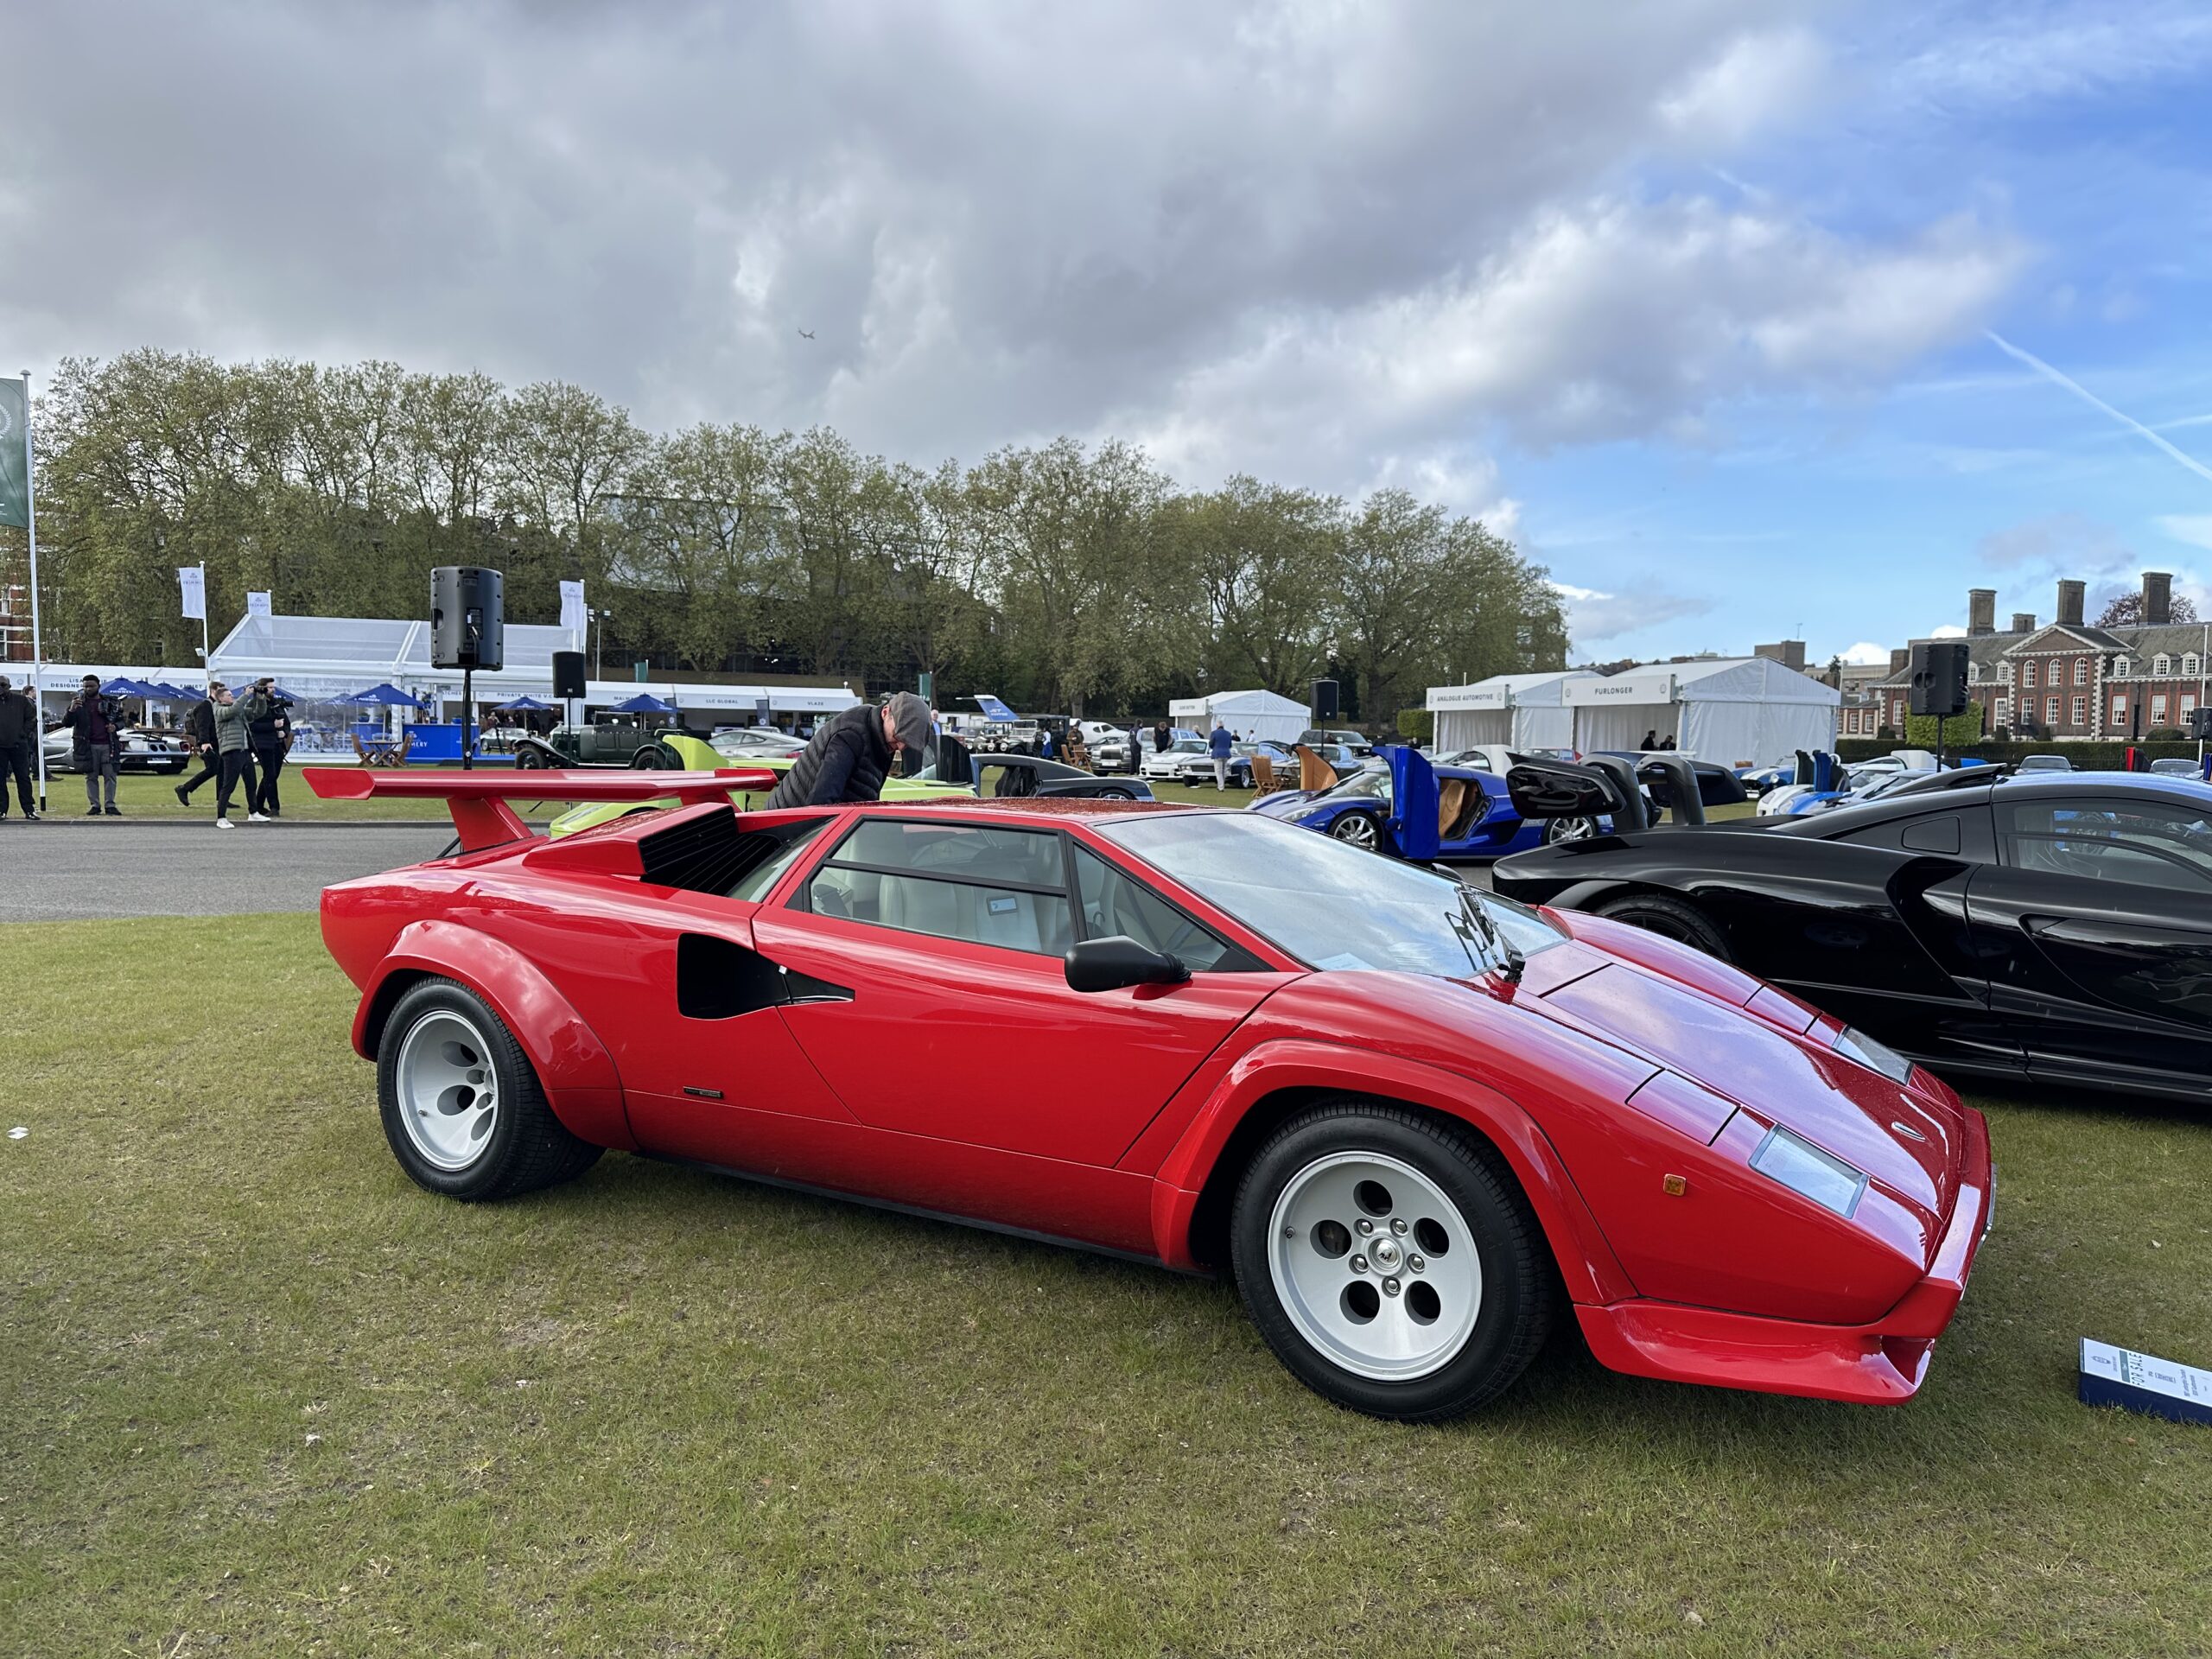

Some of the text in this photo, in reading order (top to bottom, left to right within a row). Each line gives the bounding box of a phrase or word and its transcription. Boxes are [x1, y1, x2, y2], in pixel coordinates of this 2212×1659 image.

[1594, 686, 1633, 696] FURLONGER
[2129, 1352, 2145, 1386] FOR SALE
